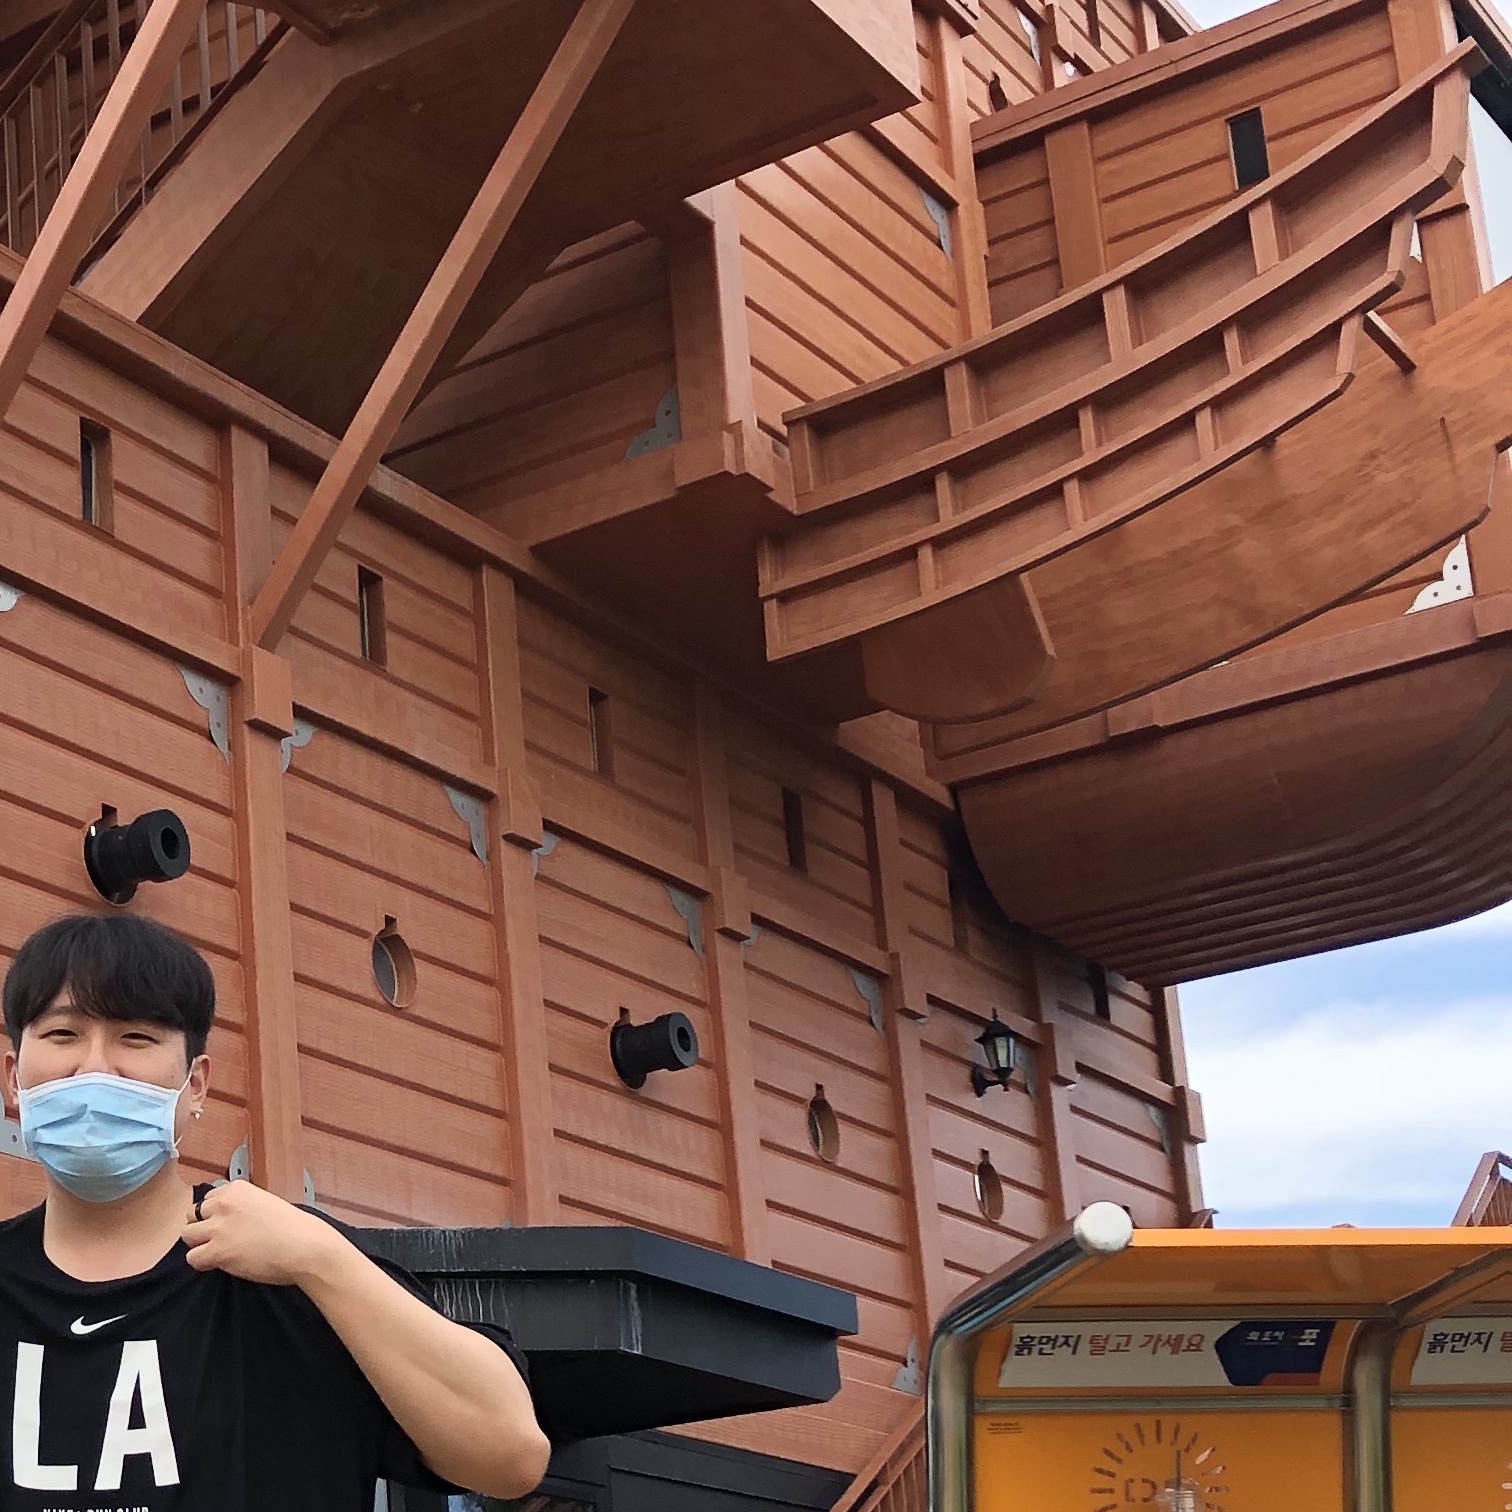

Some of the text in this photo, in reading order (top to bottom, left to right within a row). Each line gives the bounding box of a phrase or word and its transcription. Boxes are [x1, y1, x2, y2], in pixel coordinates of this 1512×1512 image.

[1014, 1333, 1205, 1357] 흙먼지 털고 가세요
[1427, 1331, 1494, 1353] 흙먼지
[12, 1339, 181, 1491] LA
